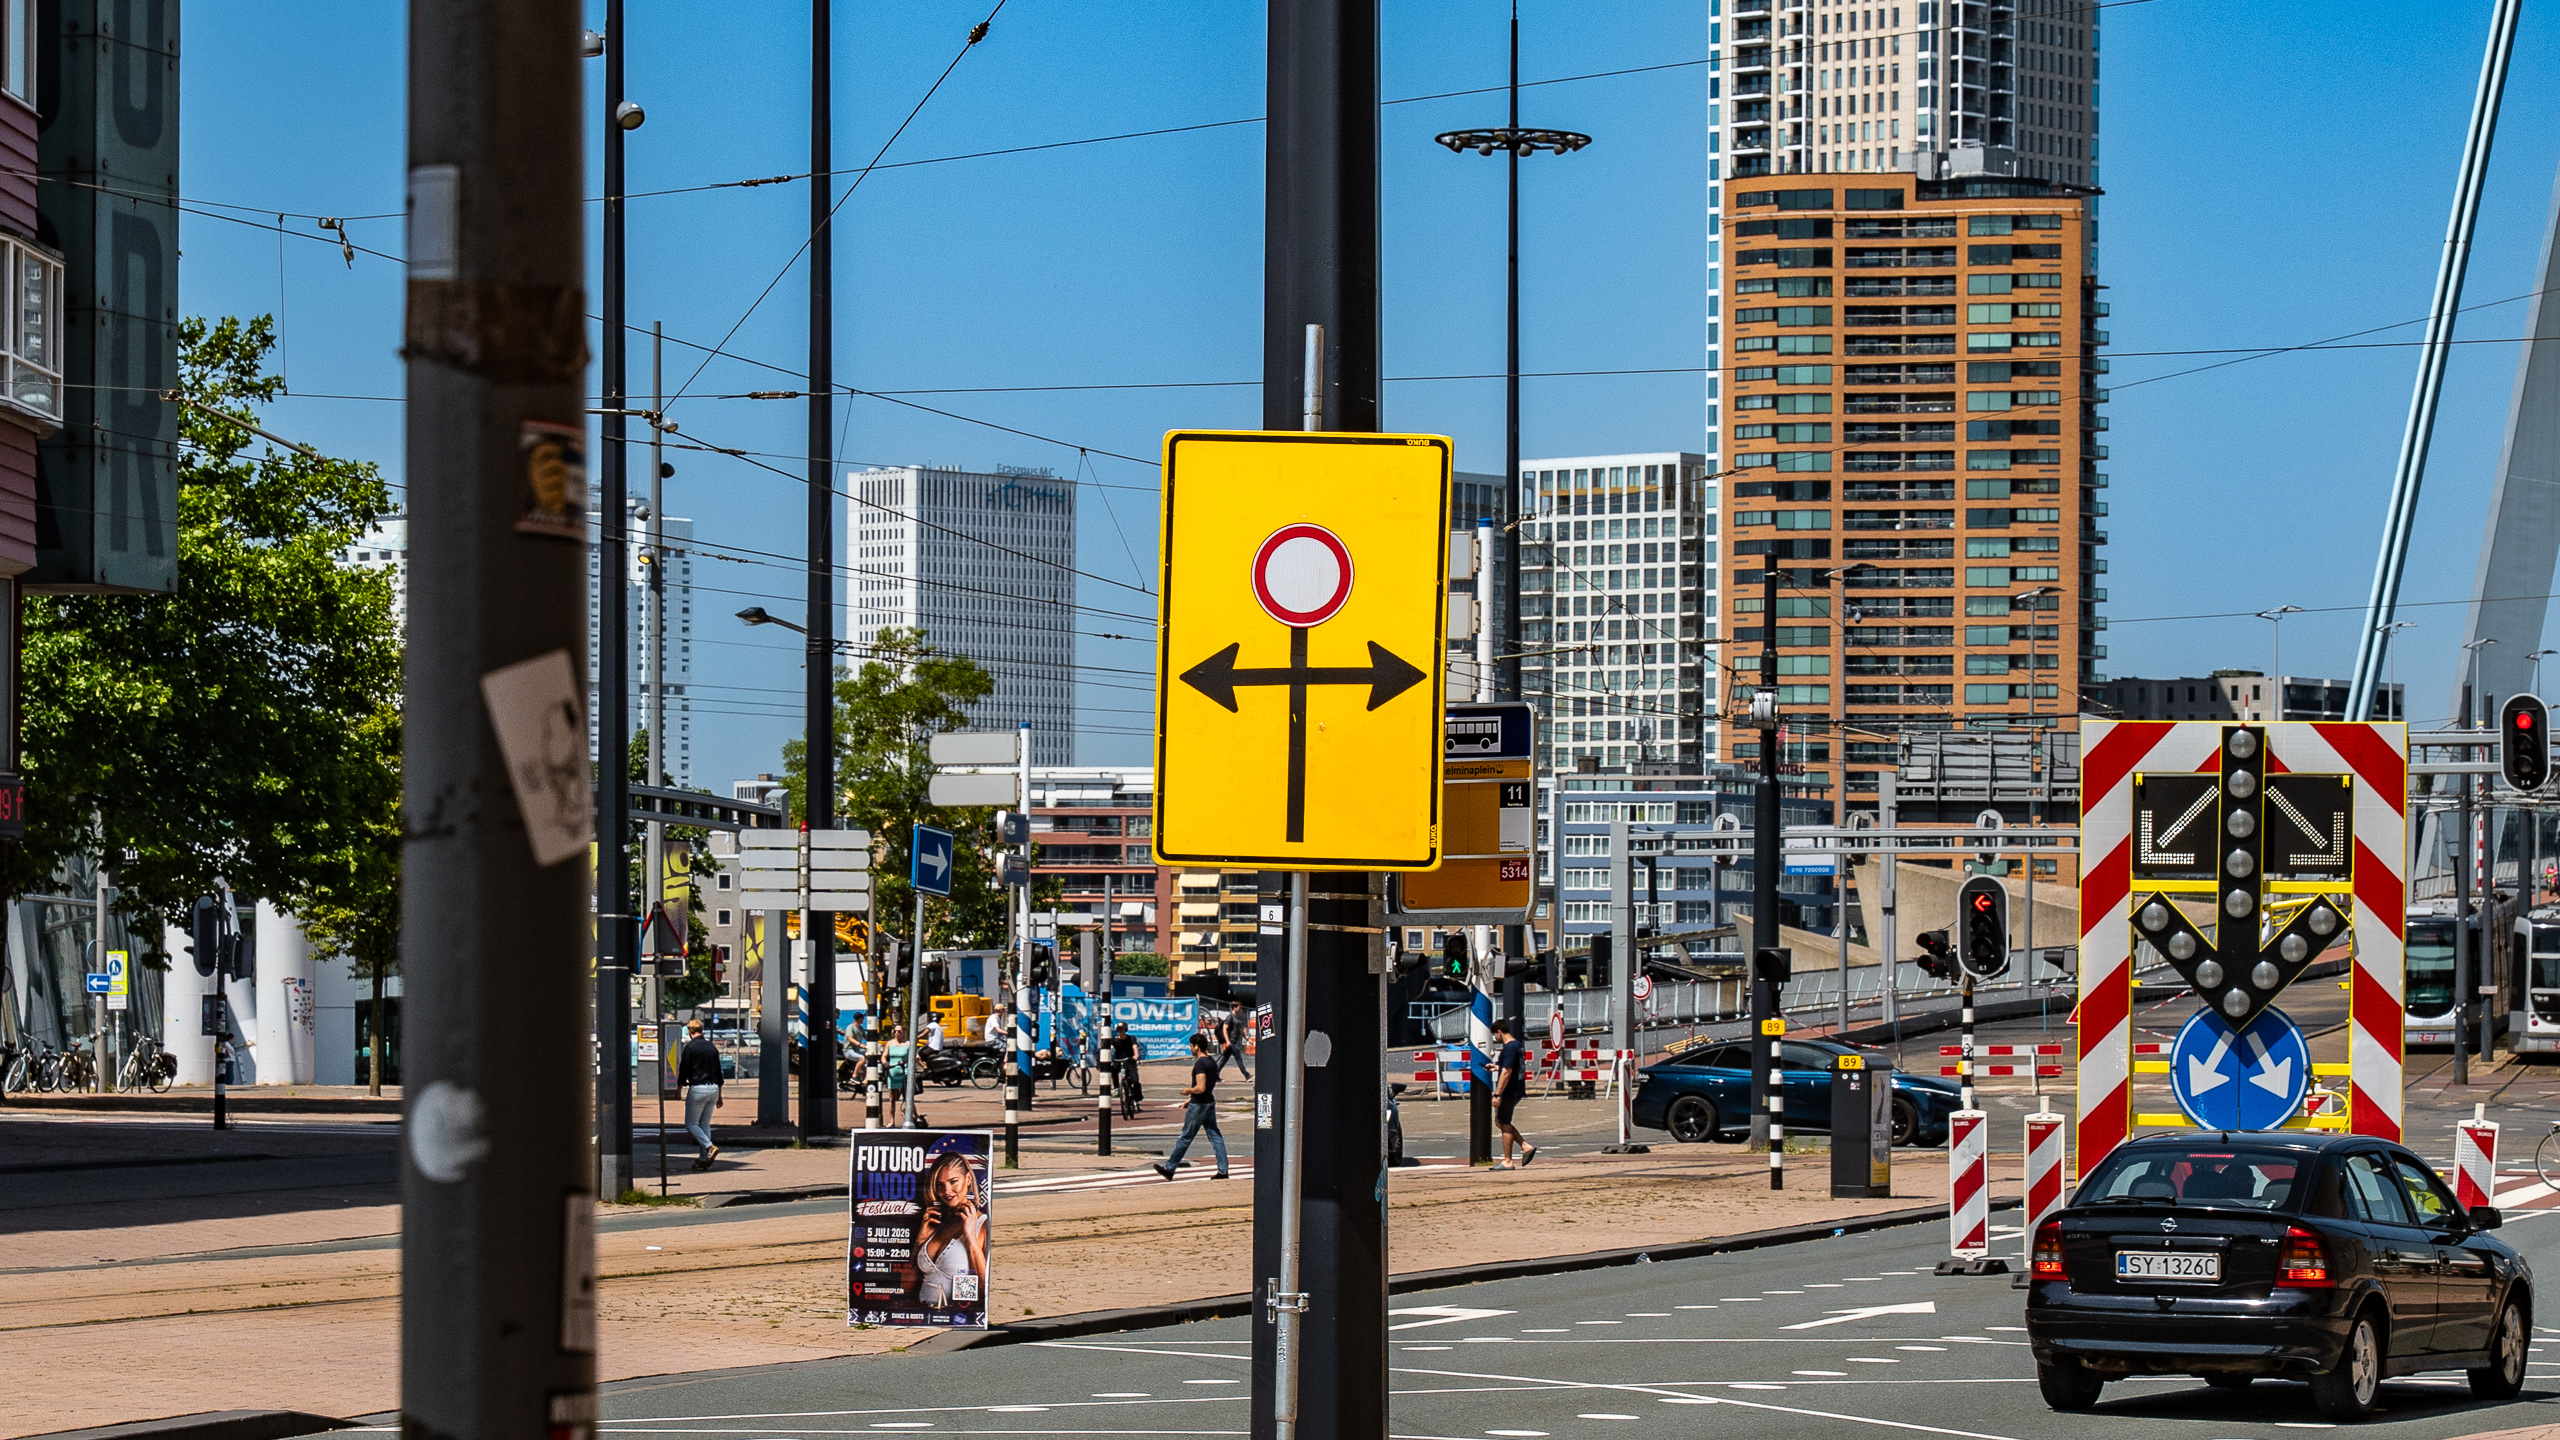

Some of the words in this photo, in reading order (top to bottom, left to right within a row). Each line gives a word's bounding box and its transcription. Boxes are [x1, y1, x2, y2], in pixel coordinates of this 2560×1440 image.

[997, 463, 1038, 476] Erasmus
[1040, 466, 1055, 478] MC
[1446, 765, 1495, 776] elminaplein
[1776, 763, 1805, 776] OTELS
[1508, 786, 1521, 800] 11
[1501, 866, 1528, 878] 5314
[1269, 910, 1273, 920] 6
[1767, 1023, 1780, 1031] 89
[2418, 1033, 2438, 1041] RET
[1843, 1057, 1857, 1067] 89
[857, 1146, 924, 1172] FUTURO
[857, 1172, 916, 1200] LINDO
[859, 1198, 912, 1216] Festival
[867, 1227, 872, 1237] 5
[874, 1227, 890, 1237] JULI
[891, 1228, 910, 1237] 2026
[867, 1248, 885, 1257] 15:00
[890, 1248, 910, 1258] 22:00
[2130, 1257, 2154, 1273] SY
[2162, 1258, 2215, 1275] 1326C
